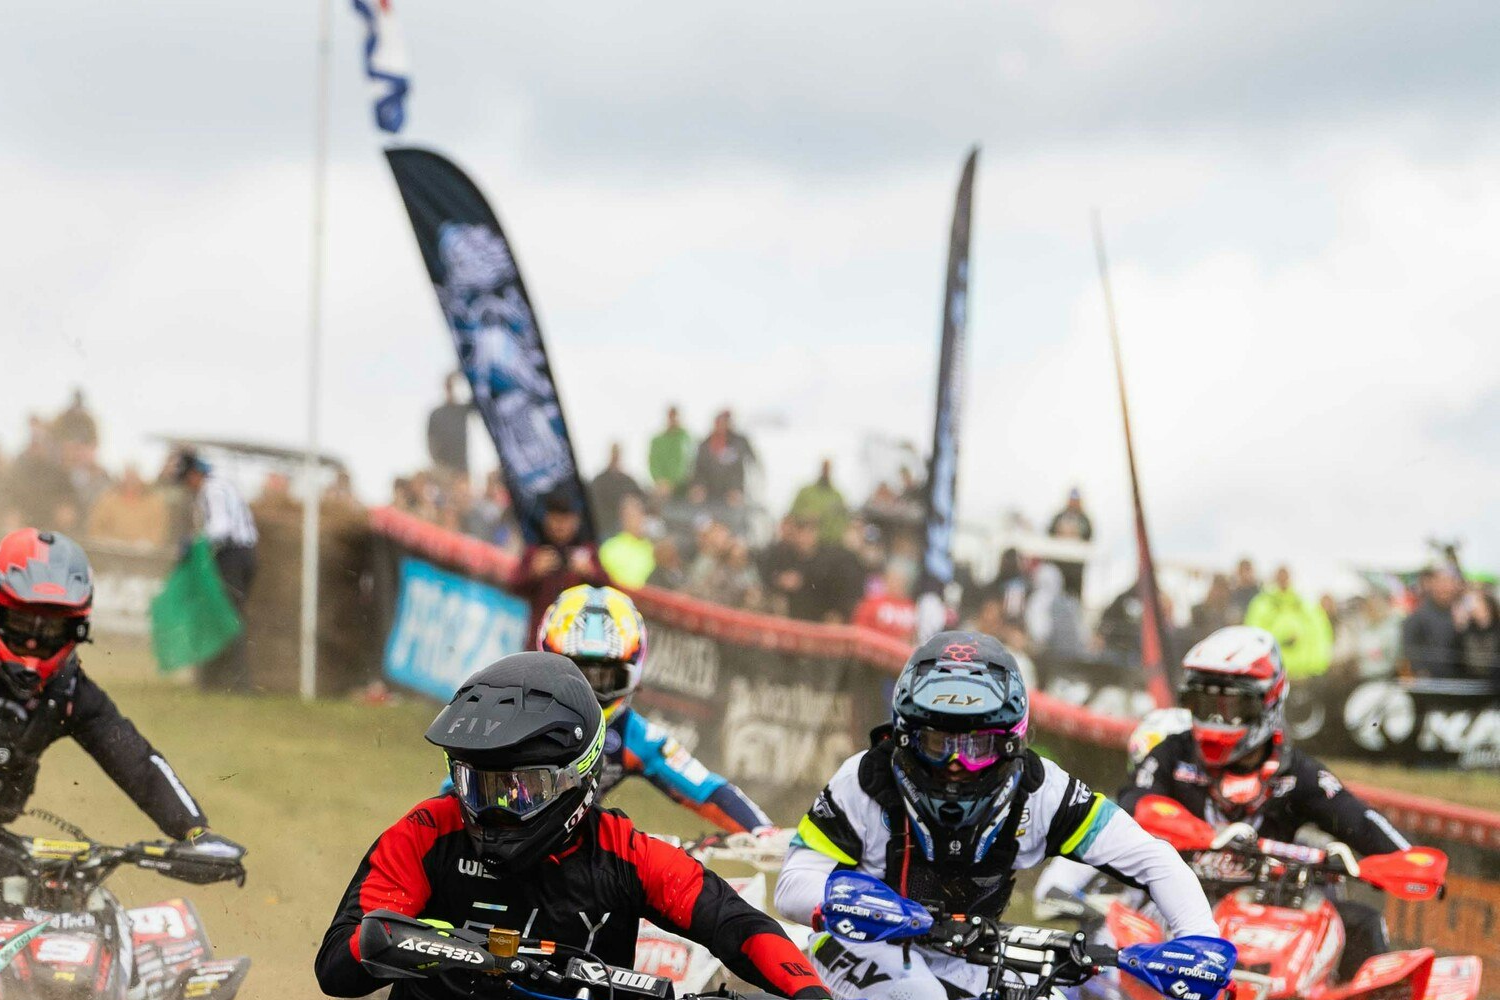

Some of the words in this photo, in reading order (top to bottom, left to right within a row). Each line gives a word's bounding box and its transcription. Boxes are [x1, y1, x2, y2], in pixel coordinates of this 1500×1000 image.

[931, 694, 982, 706] FLY
[832, 903, 871, 917] FOWLER
[397, 937, 485, 965] ACERBIS
[830, 950, 892, 990] FLY
[1178, 965, 1218, 982] FOWLER
